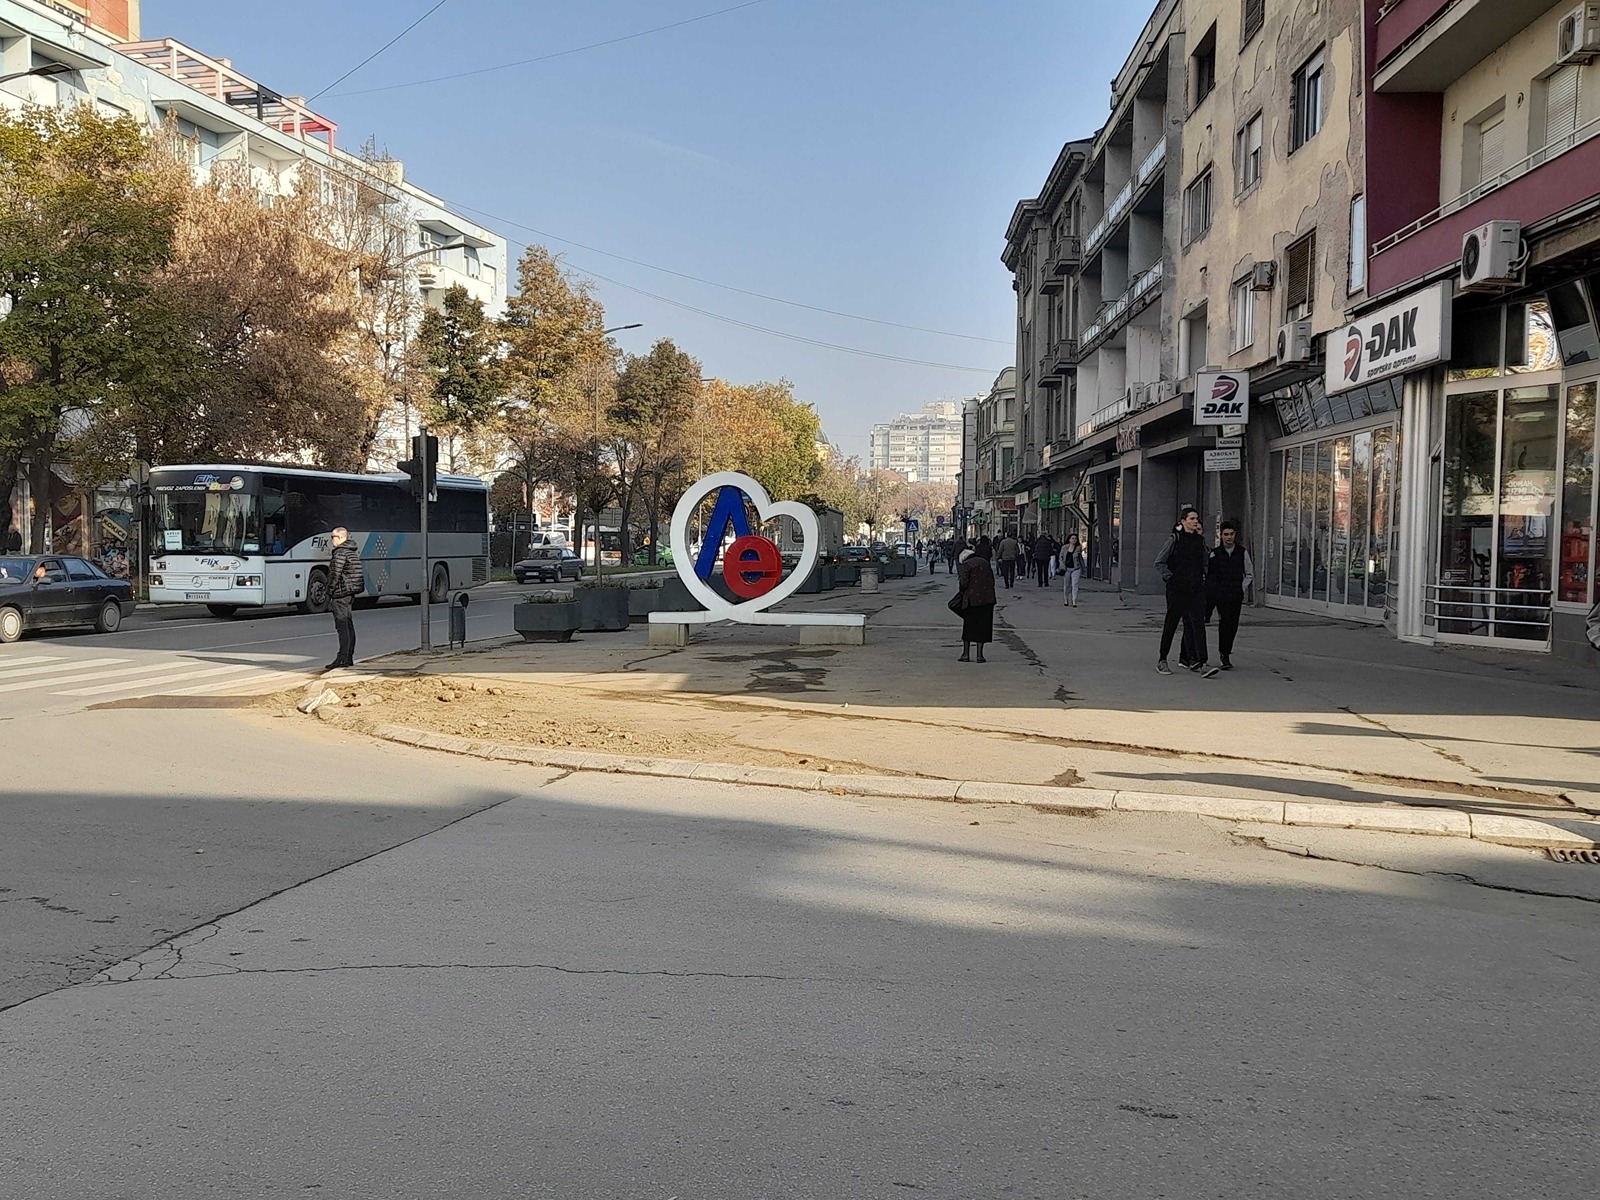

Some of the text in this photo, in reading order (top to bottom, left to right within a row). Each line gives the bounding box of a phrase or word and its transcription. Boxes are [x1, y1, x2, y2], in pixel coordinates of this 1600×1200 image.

[1393, 354, 1417, 370] oprema
[311, 536, 329, 548] Flix
[200, 558, 219, 566] Flix
